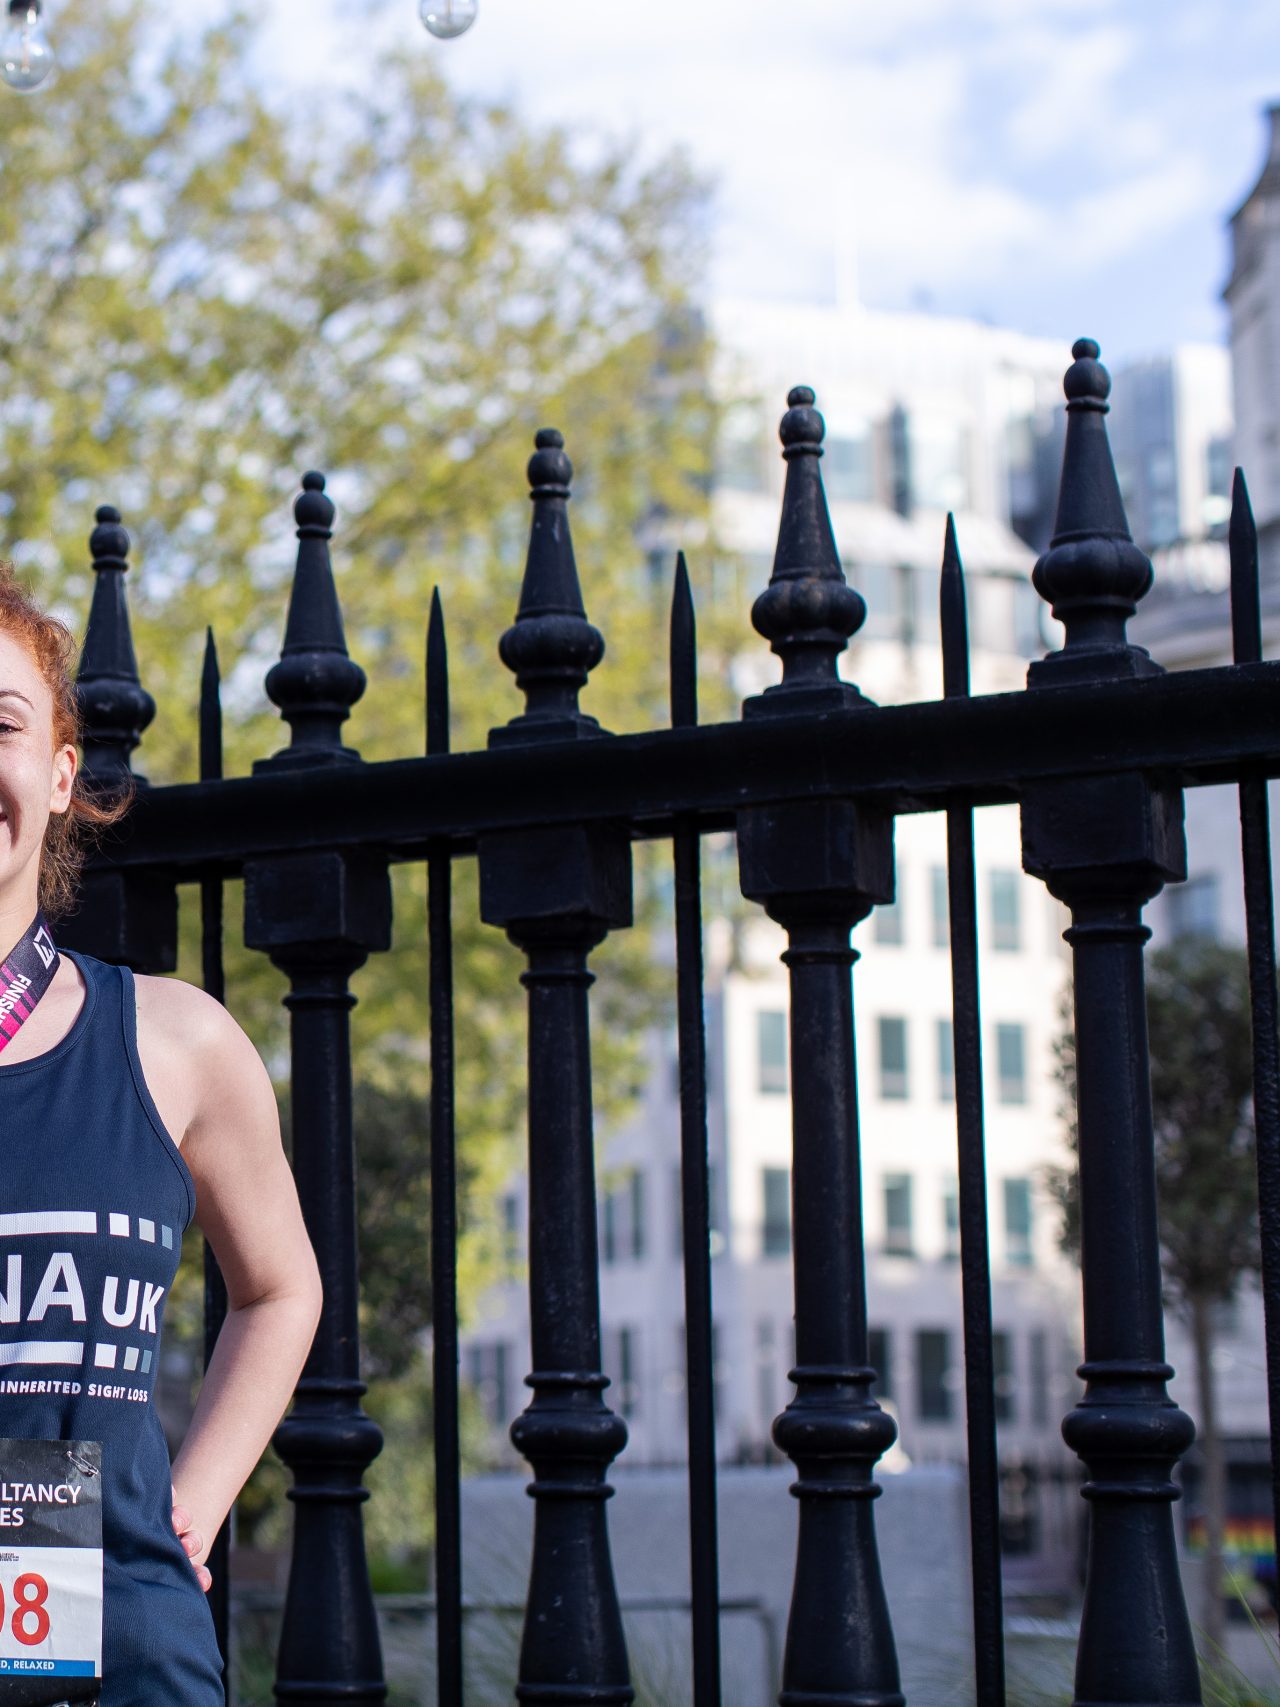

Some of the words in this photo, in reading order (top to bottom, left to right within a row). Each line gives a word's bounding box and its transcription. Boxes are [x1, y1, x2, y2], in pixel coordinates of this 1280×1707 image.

[101, 1275, 165, 1334] UK
[0, 1380, 82, 1396] INHERITED
[87, 1383, 126, 1400] SIGHT
[127, 1387, 149, 1403] LOSS
[13, 1659, 55, 1671] RELAXED
